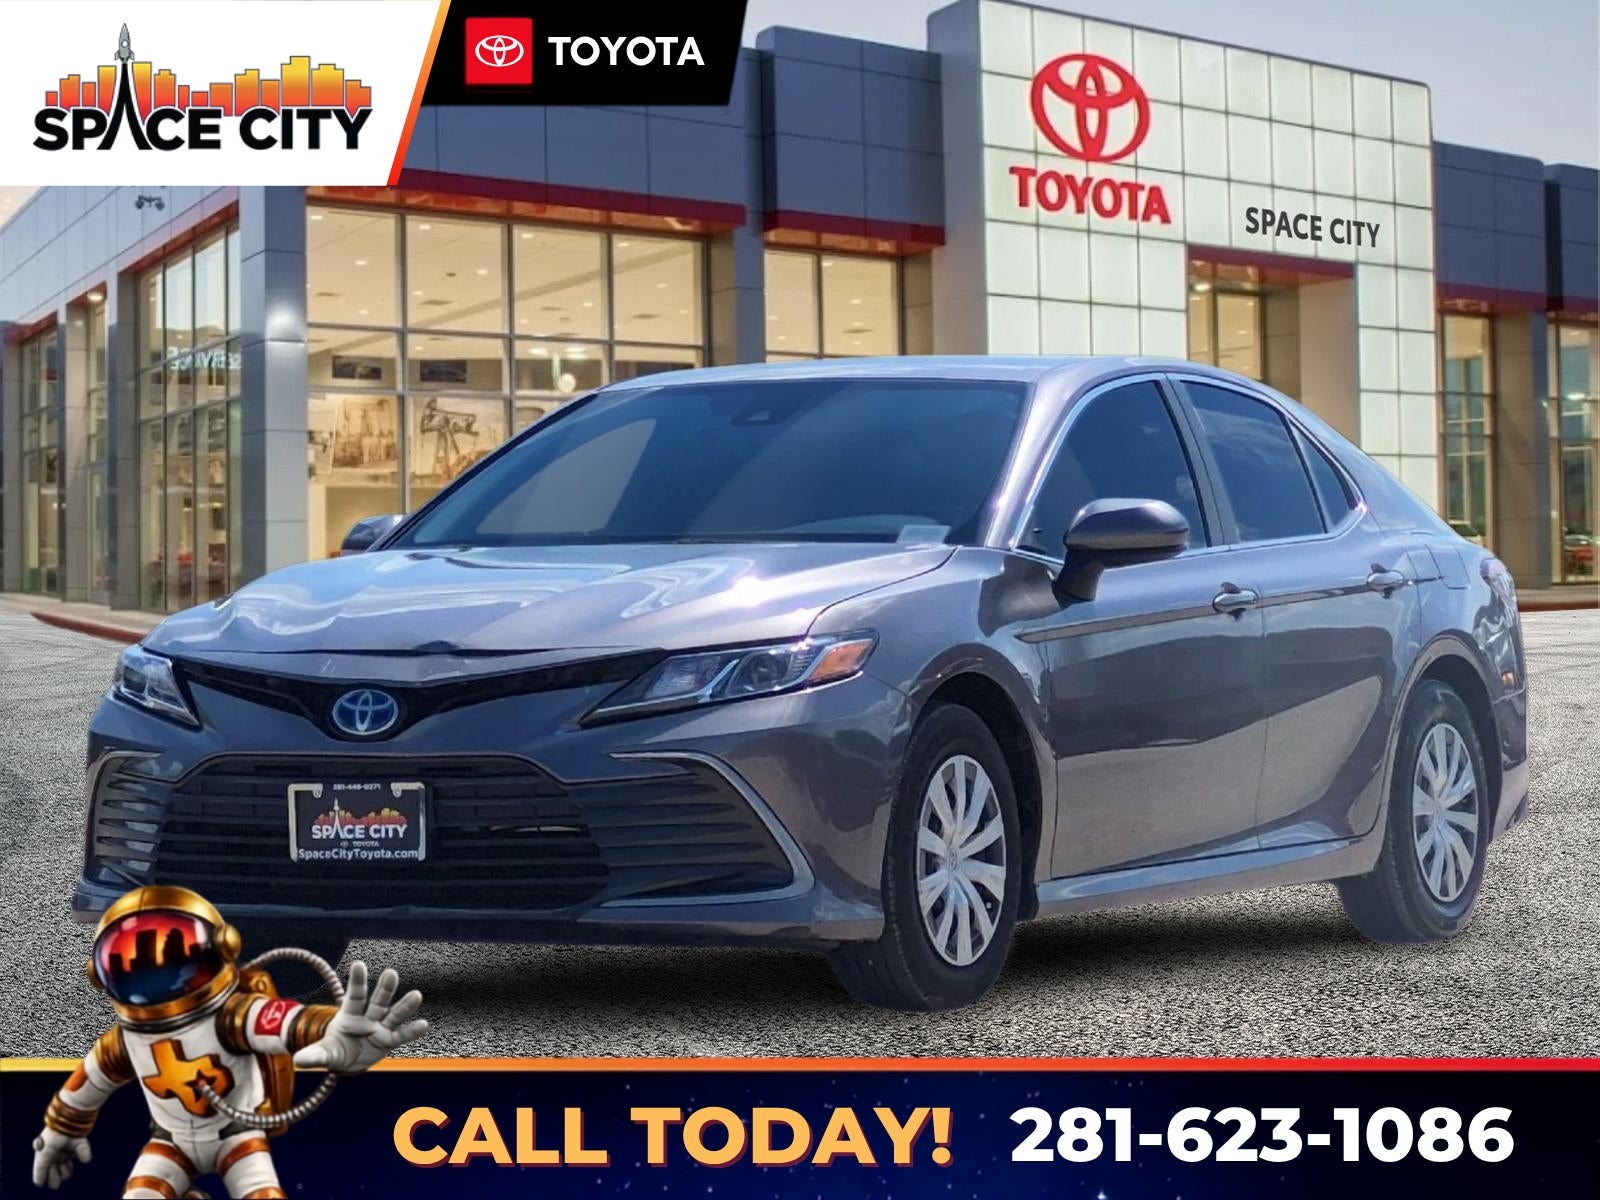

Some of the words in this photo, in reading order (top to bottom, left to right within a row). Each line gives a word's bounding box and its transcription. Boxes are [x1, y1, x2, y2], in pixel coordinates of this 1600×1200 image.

[1009, 166, 1171, 224] TOYOTA
[1245, 206, 1322, 242] SPACE
[1329, 218, 1380, 248] CITY
[312, 824, 365, 839] SPACE
[369, 824, 407, 839] CITY
[299, 849, 417, 861] SpaceCityToyota.com
